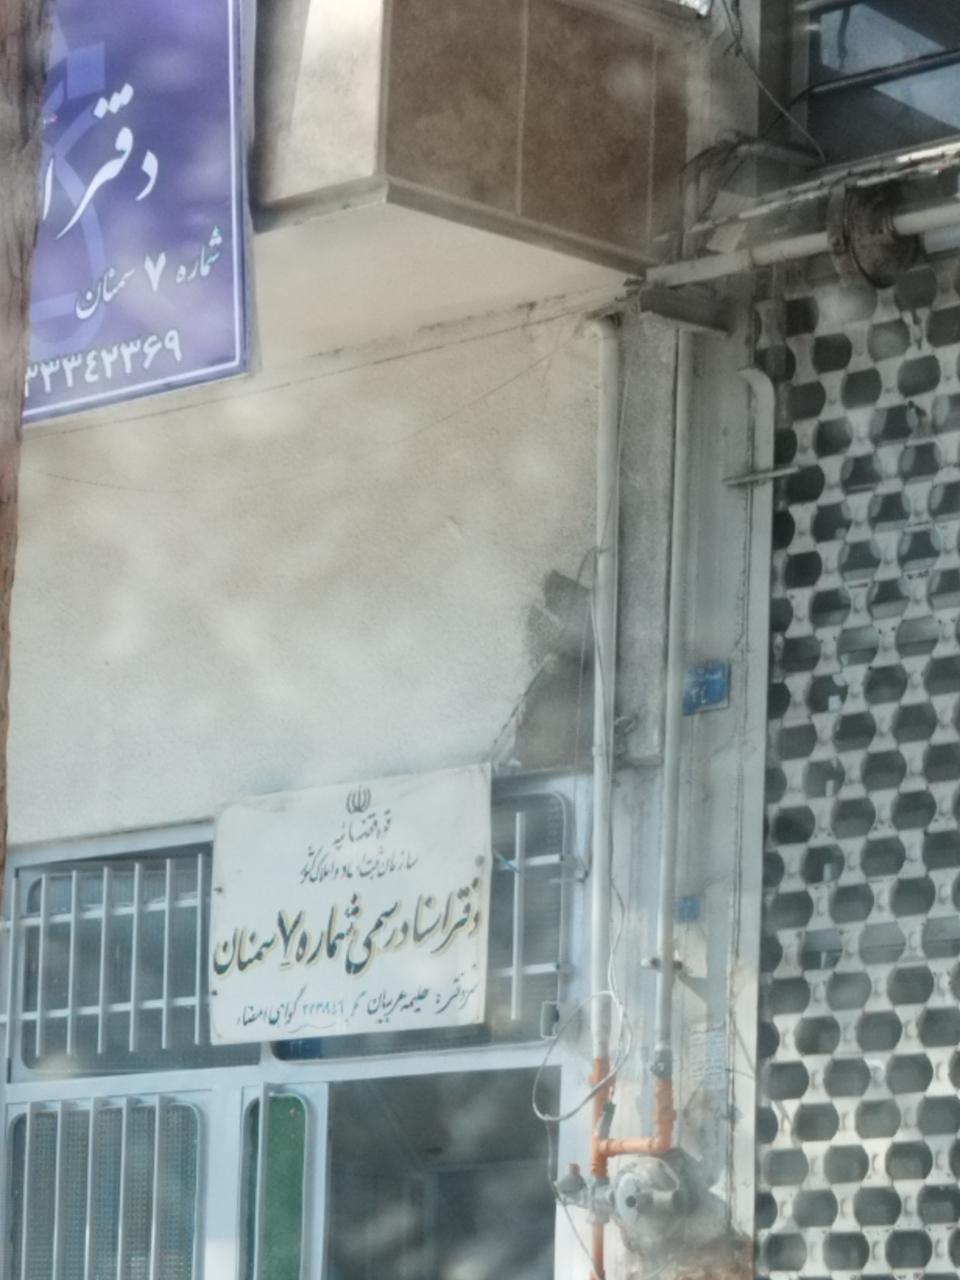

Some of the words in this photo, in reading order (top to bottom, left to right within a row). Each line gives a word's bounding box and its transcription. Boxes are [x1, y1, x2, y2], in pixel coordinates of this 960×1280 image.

[143, 252, 168, 292] ۷
[175, 227, 224, 284] شماره
[74, 266, 137, 320] سمنان
[277, 908, 304, 966] ۷
[295, 891, 361, 966] شماره
[345, 900, 400, 976] رسمی
[399, 890, 453, 951] اسناد
[430, 876, 481, 955] دفتر
[213, 926, 276, 976] سمنان
